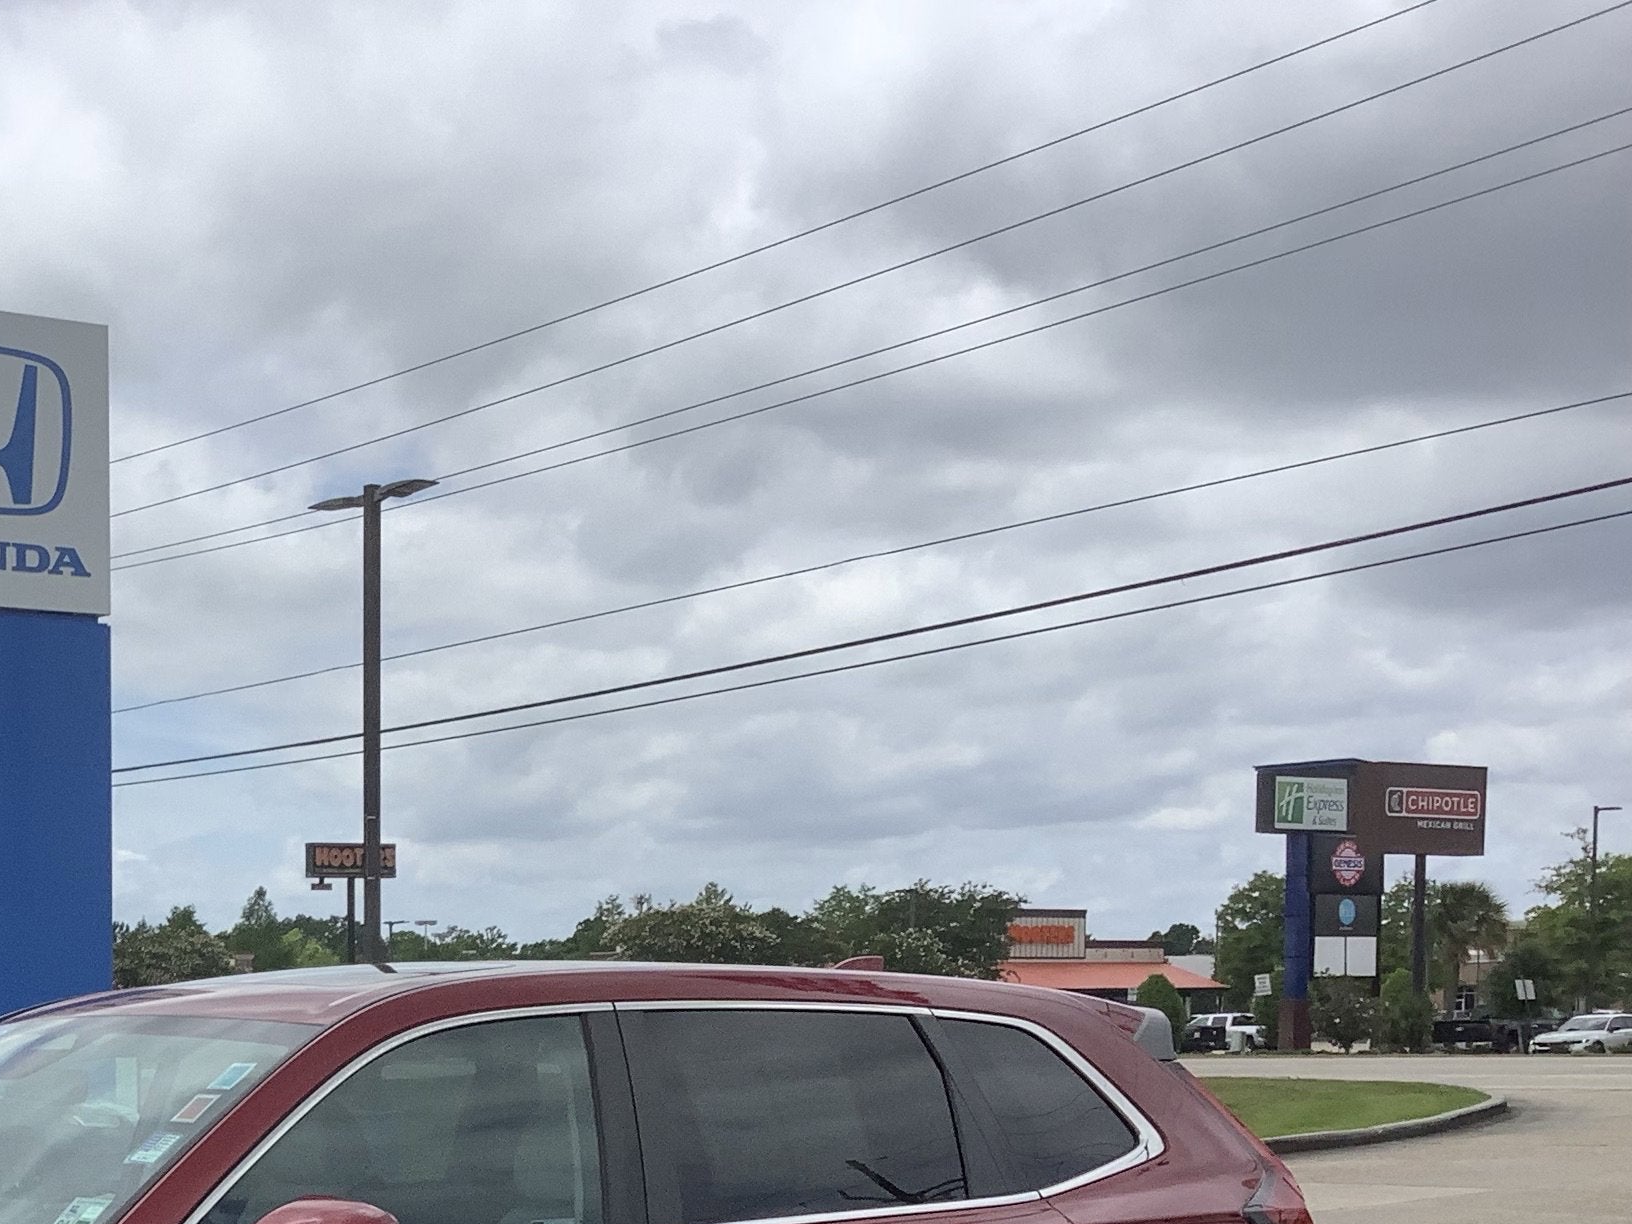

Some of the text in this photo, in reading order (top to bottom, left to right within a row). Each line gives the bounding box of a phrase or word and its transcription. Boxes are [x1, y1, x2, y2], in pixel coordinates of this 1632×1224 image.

[1306, 795, 1345, 814] Express
[1407, 795, 1477, 813] CHIPOTLE
[1416, 820, 1474, 831] MEXICAN GRILL
[315, 847, 396, 868] HOOTS
